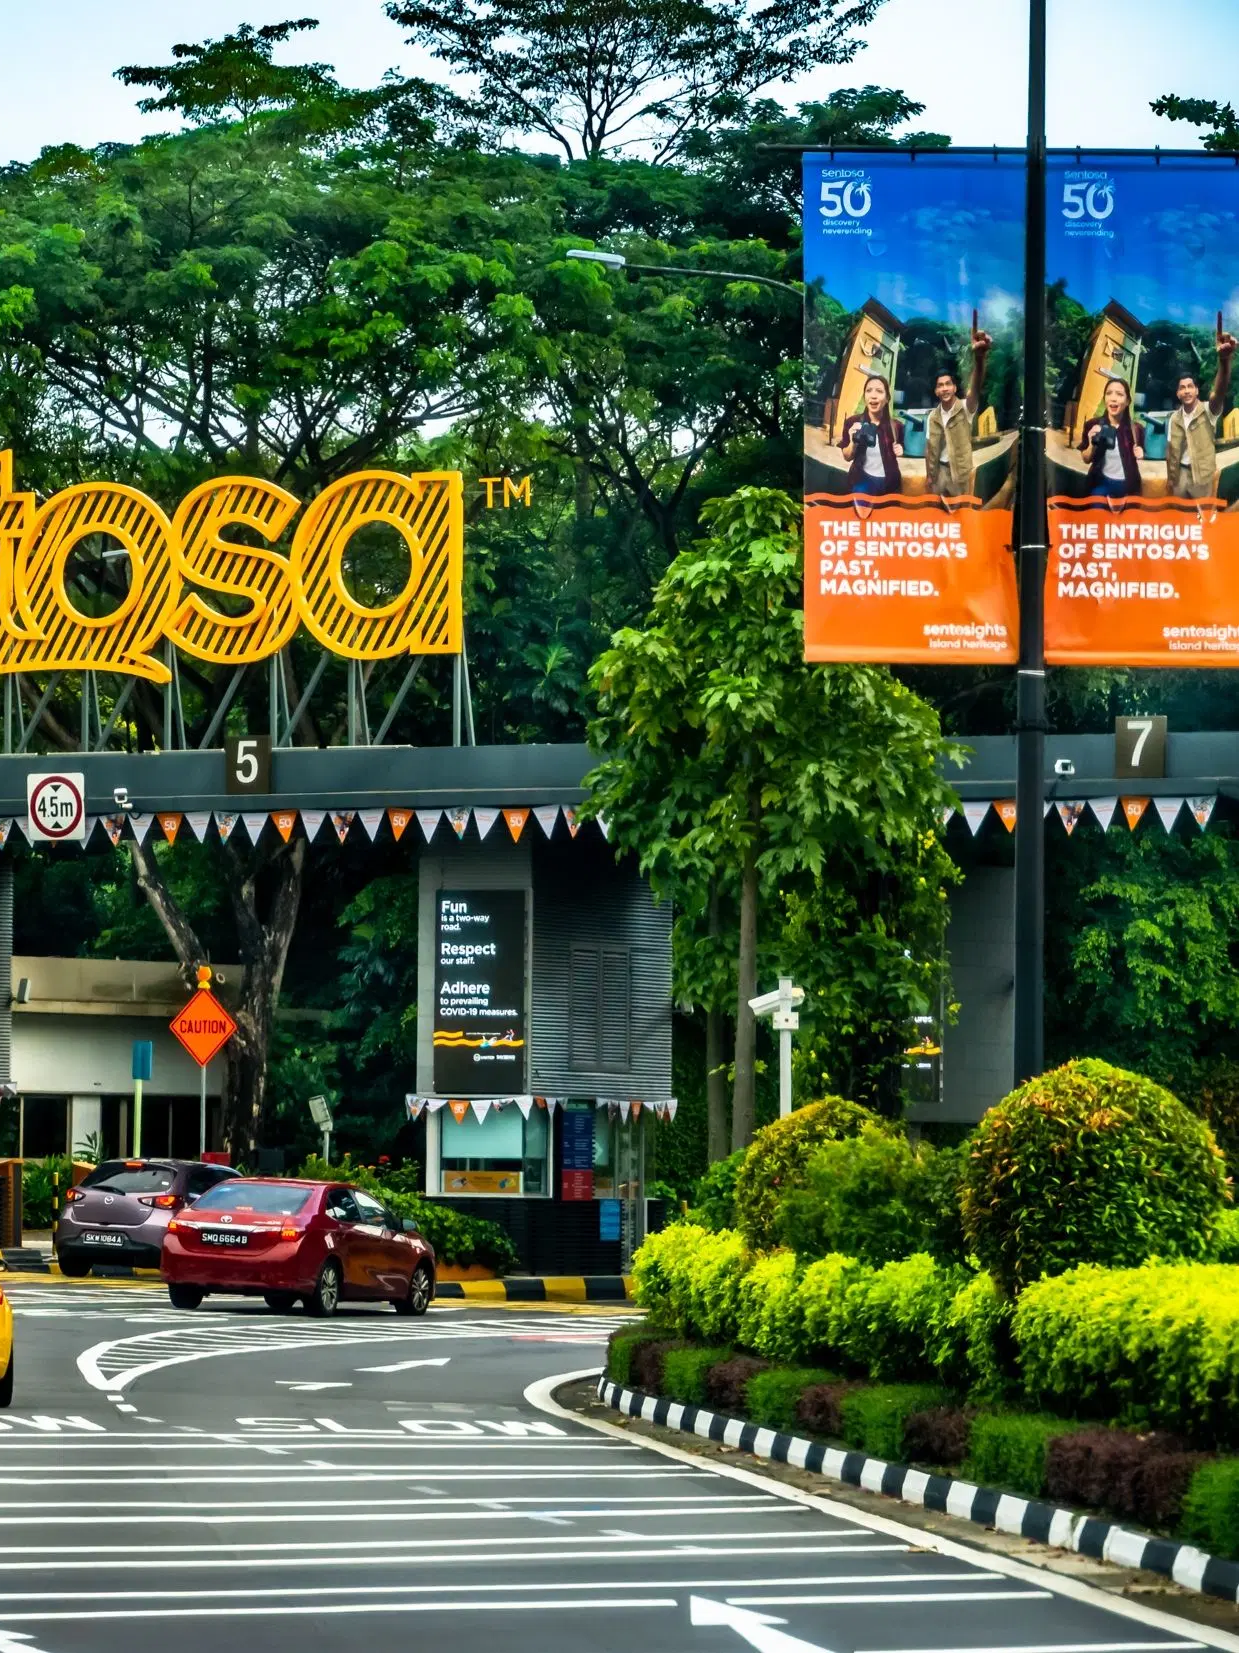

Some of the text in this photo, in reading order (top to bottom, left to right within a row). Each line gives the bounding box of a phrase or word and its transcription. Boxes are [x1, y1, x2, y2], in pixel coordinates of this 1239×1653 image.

[822, 169, 864, 178] sentosa
[1064, 170, 1107, 180] sentosa
[819, 180, 872, 217] 50
[1061, 182, 1115, 220] 50
[822, 219, 860, 227] discovery
[1064, 220, 1102, 229] discovery
[822, 228, 872, 236] neverending
[1064, 229, 1114, 238] neverending
[478, 476, 531, 508] TM
[820, 521, 961, 539] THE INTRIGUE
[1059, 524, 1203, 540] THE INTRIGUE
[820, 540, 968, 558] OF SENTOSA'S
[1059, 543, 1210, 560] OF SENTOSA'S
[820, 560, 879, 579] PAST,
[1059, 562, 1117, 581] PAST,
[820, 579, 939, 597] MAGNIFIED.
[1058, 582, 1180, 599] MAGNIFIED.
[923, 623, 1007, 638] sentosights
[929, 638, 1007, 651] island heritage
[1169, 641, 1202, 650] island
[1127, 720, 1153, 767] 7
[235, 740, 258, 784] 5
[37, 796, 73, 818] 4.5m
[393, 816, 406, 827] 50
[441, 900, 467, 913] Fun
[441, 914, 447, 922] is
[456, 914, 489, 923] two-way
[441, 923, 461, 931] road.
[441, 942, 496, 957] Respect
[455, 957, 475, 965] staff.
[440, 981, 490, 994] Adhere
[440, 997, 488, 1007] to prevailing
[440, 1008, 518, 1016] COVID-19 measures.
[180, 1020, 226, 1034] CAUTION
[235, 1417, 568, 1436] SLOW
